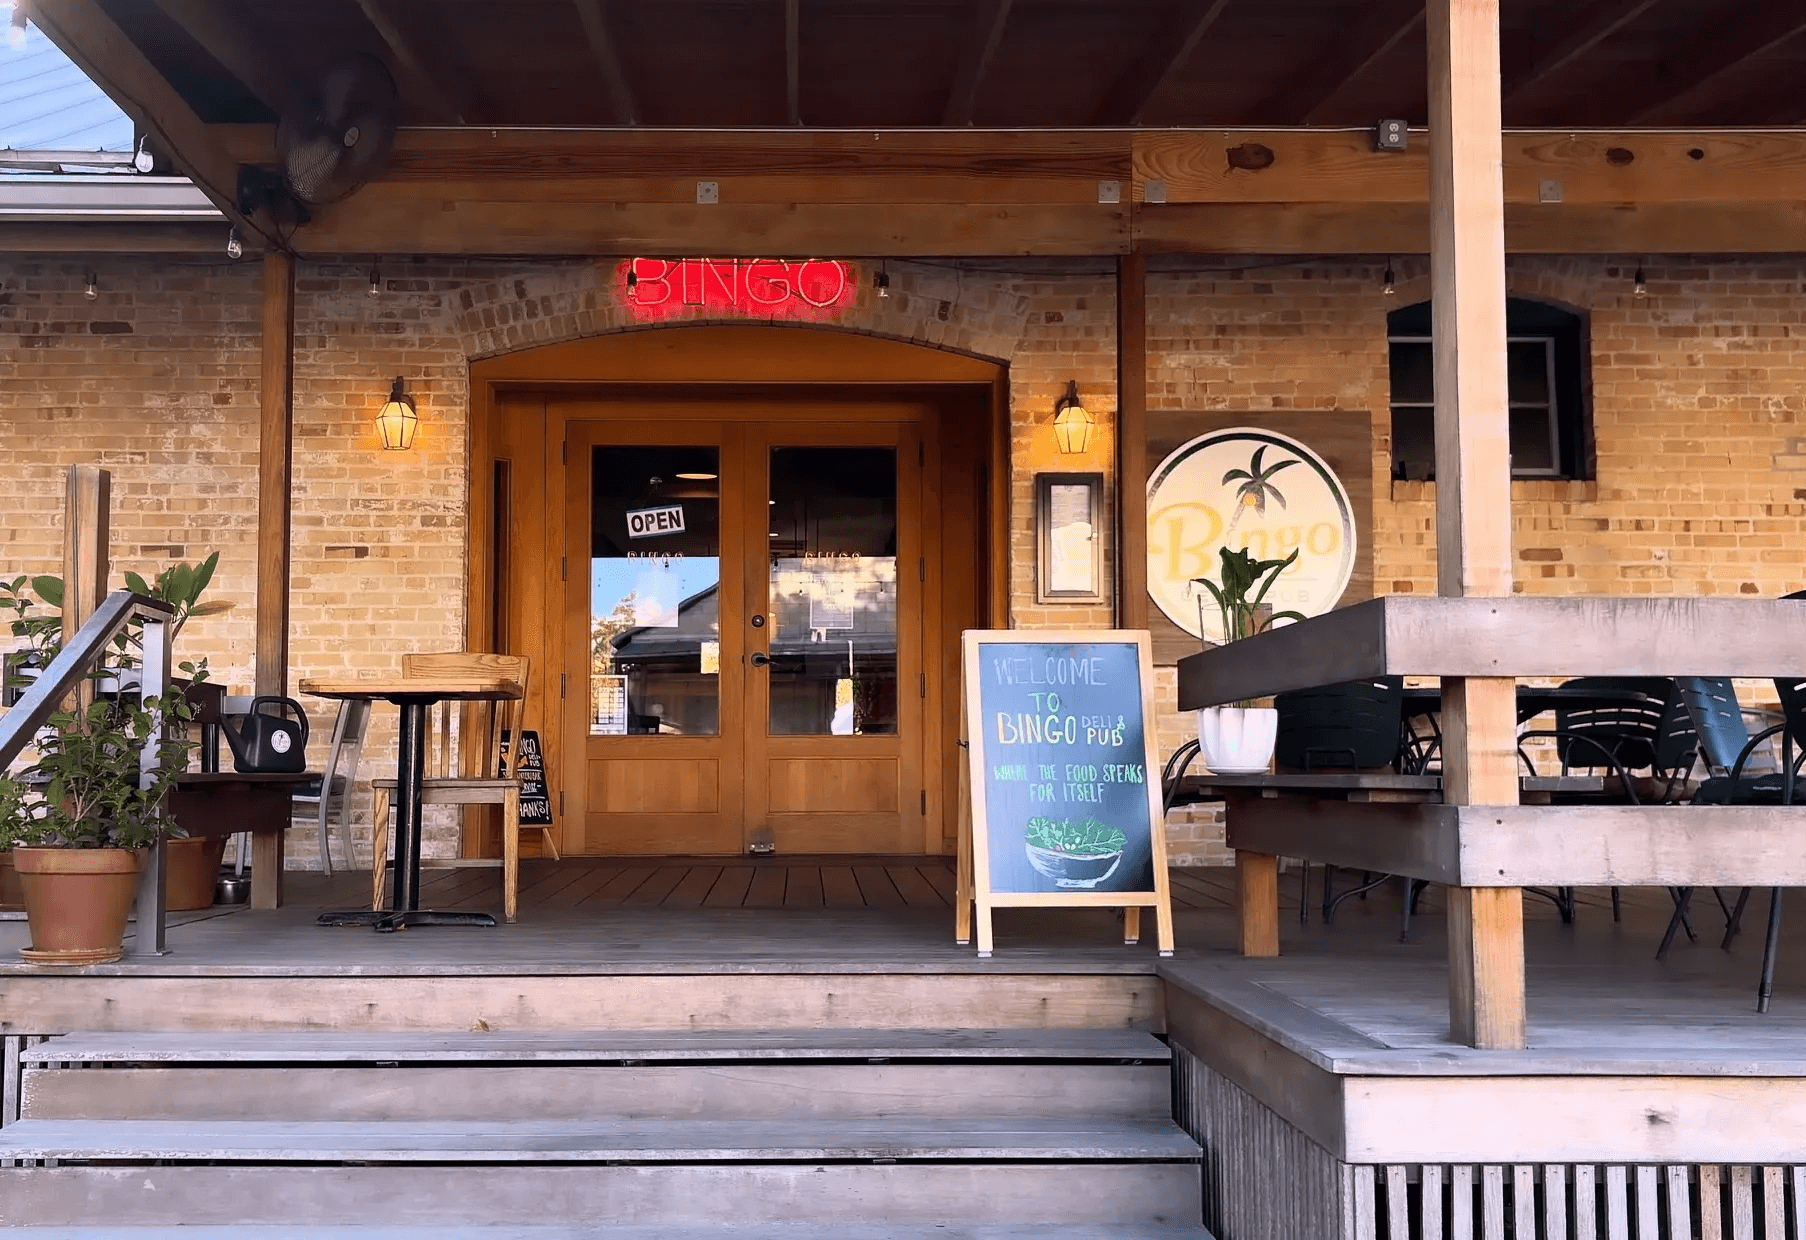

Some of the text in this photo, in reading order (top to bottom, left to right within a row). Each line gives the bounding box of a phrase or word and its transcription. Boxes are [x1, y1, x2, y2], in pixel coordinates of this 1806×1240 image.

[633, 257, 845, 307] BINGO
[631, 510, 681, 533] OPEN
[993, 656, 1107, 686] WELCOME
[1028, 692, 1061, 713] TO
[997, 711, 1077, 745] BINGO
[1081, 715, 1112, 729] DELI
[1086, 727, 1124, 747] PUB
[1038, 764, 1058, 781] THE
[1065, 764, 1098, 782] FOOD
[1102, 764, 1144, 784] SPEAKS
[1029, 782, 1105, 804] FOR ITSELF
